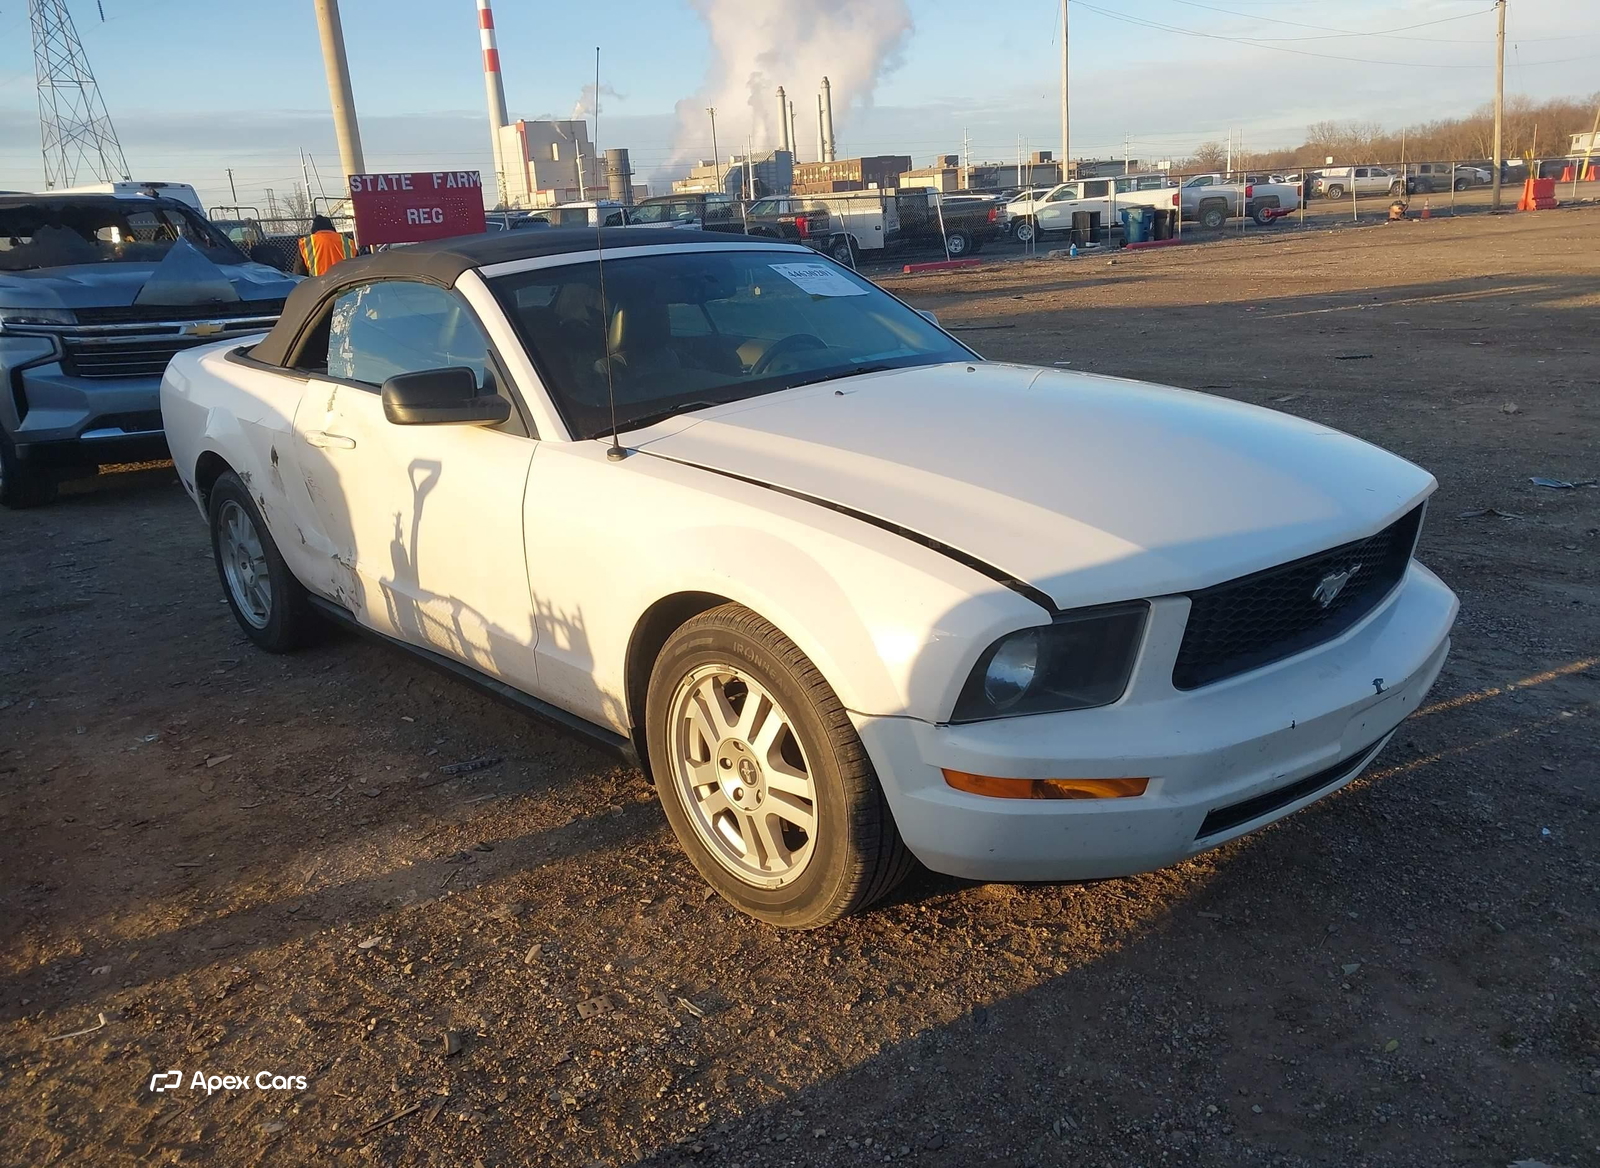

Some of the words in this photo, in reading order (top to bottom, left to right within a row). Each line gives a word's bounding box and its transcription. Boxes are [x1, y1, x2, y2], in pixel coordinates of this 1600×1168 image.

[350, 173, 414, 192] STATE
[432, 171, 482, 189] FARM
[406, 207, 444, 225] REG
[733, 641, 792, 698] IRONHEAD
